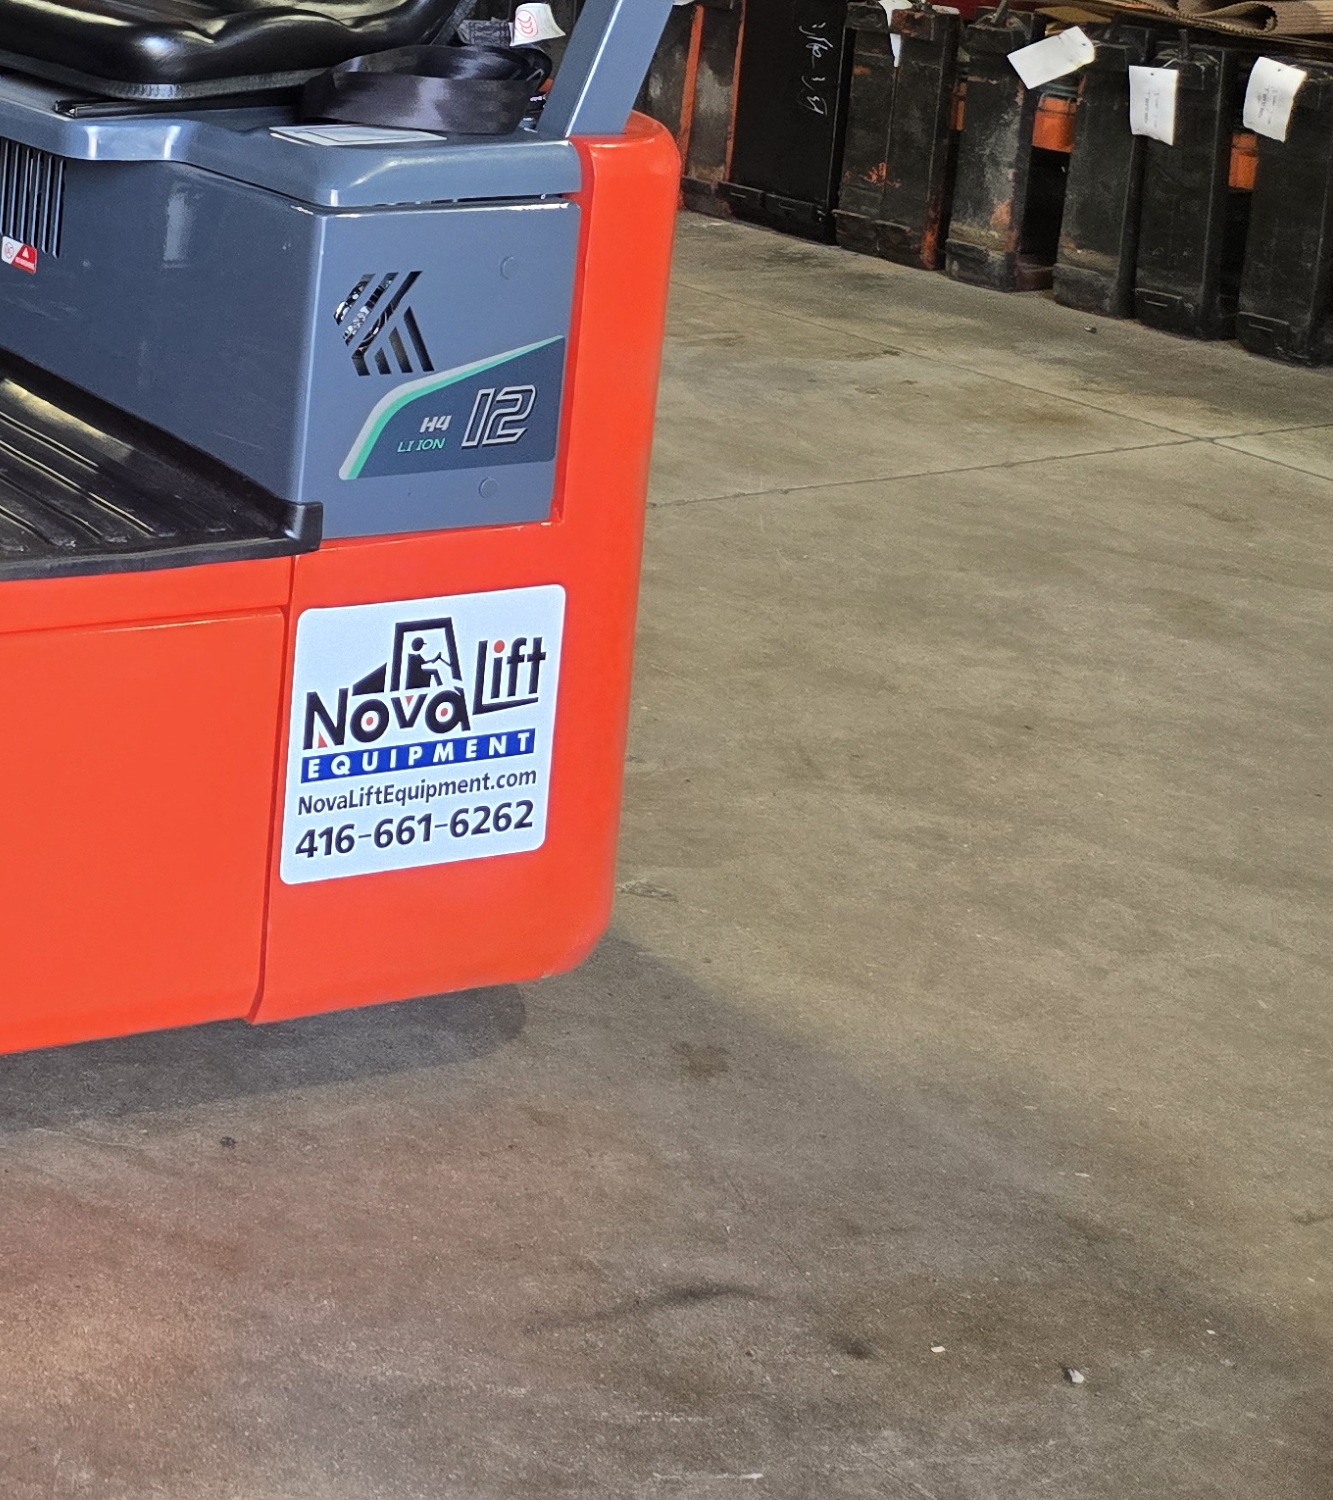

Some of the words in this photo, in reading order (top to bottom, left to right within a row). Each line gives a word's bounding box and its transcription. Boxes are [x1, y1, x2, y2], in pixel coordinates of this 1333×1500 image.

[419, 414, 452, 433] H4
[461, 384, 537, 450] 12
[397, 440, 414, 453] LI
[415, 437, 446, 451] ION
[307, 731, 532, 779] EQUIPMENT
[297, 769, 537, 816] NovaLiftEquipment.com
[295, 799, 534, 859] 416-661-6262
